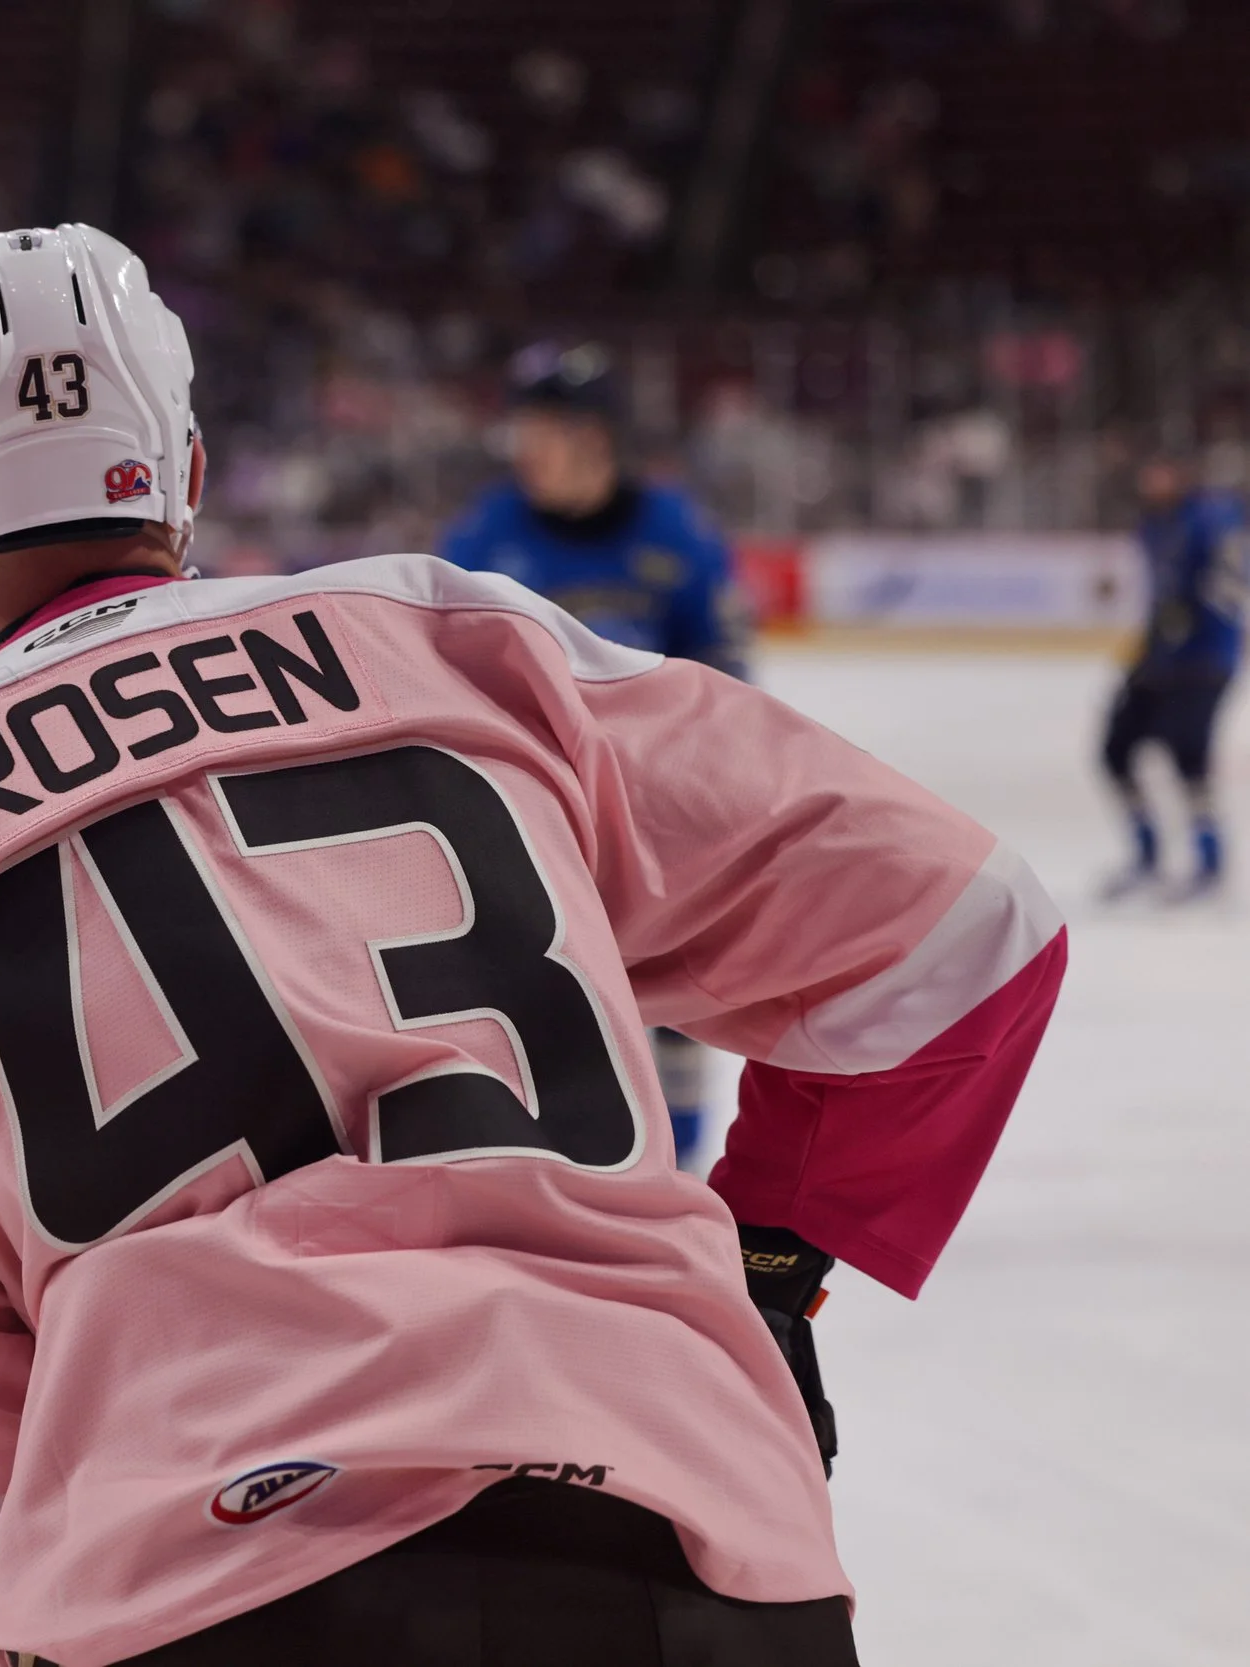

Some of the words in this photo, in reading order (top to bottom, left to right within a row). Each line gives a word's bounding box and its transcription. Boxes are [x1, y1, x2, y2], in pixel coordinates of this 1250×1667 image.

[17, 353, 91, 423] 43
[23, 597, 140, 653] CCM
[740, 1249, 799, 1267] CM
